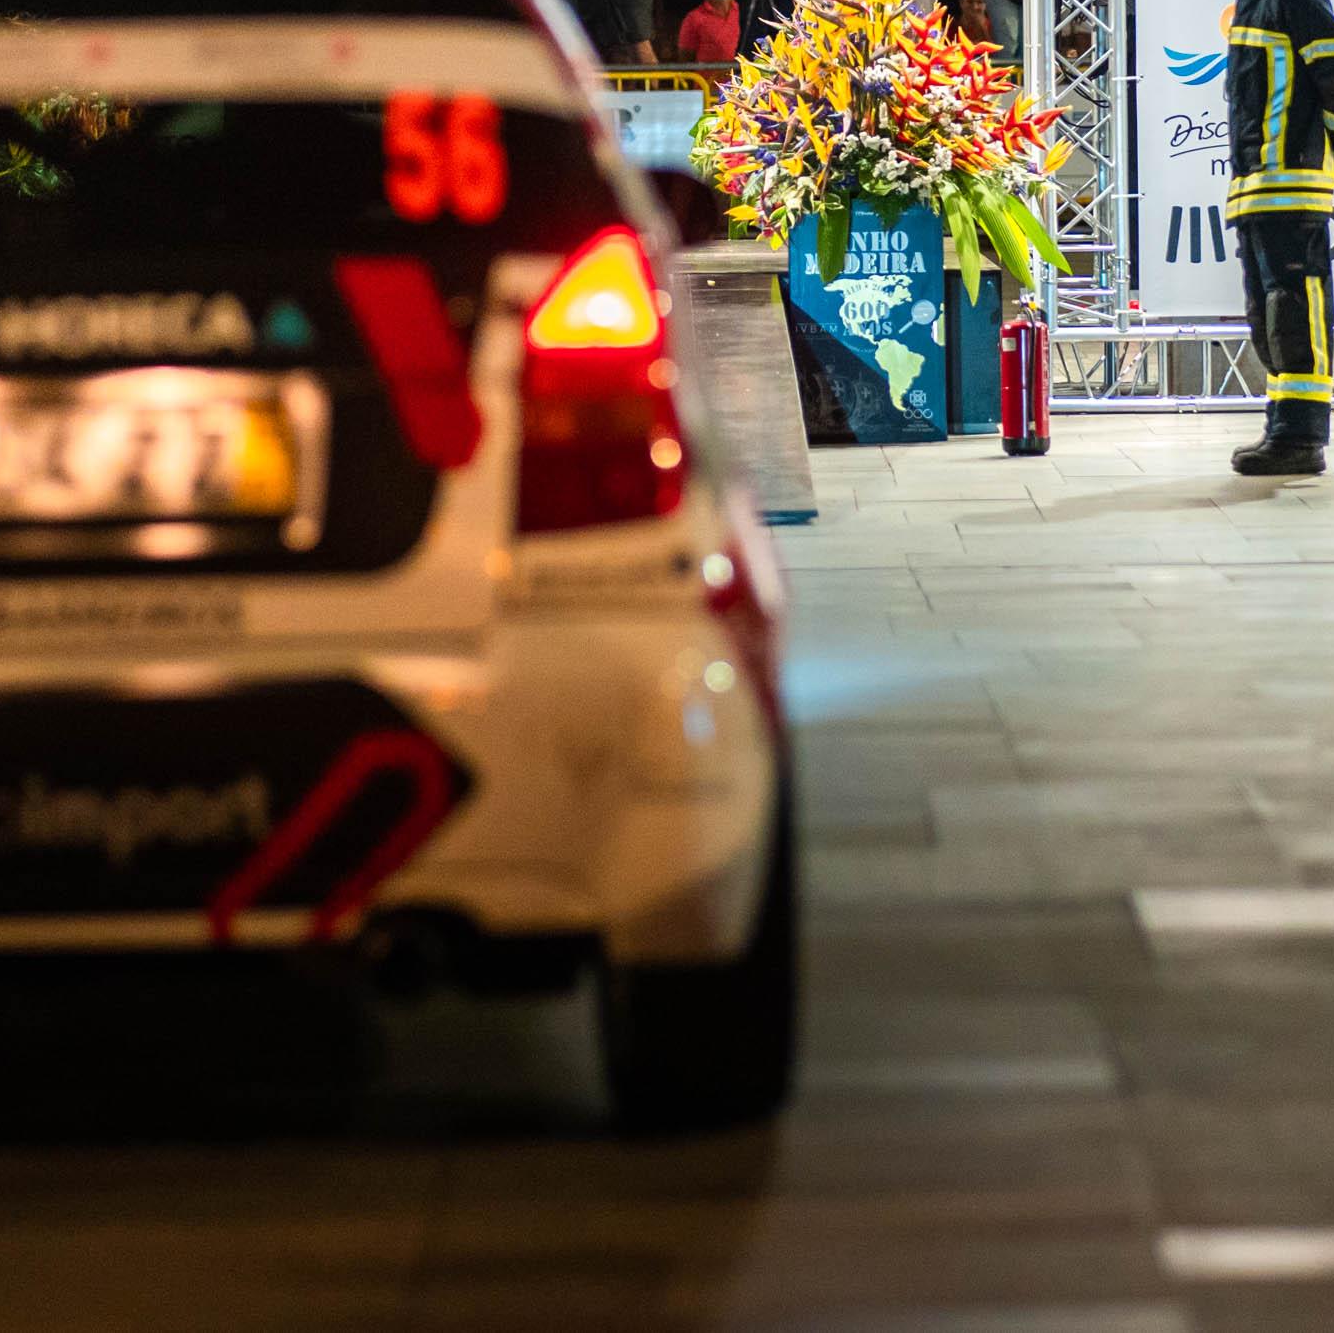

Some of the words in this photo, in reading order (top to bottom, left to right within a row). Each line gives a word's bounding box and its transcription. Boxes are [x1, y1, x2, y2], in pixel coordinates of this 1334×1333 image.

[1164, 112, 1231, 148] Disc
[847, 230, 909, 252] NHO
[805, 251, 927, 275] MDEIRA
